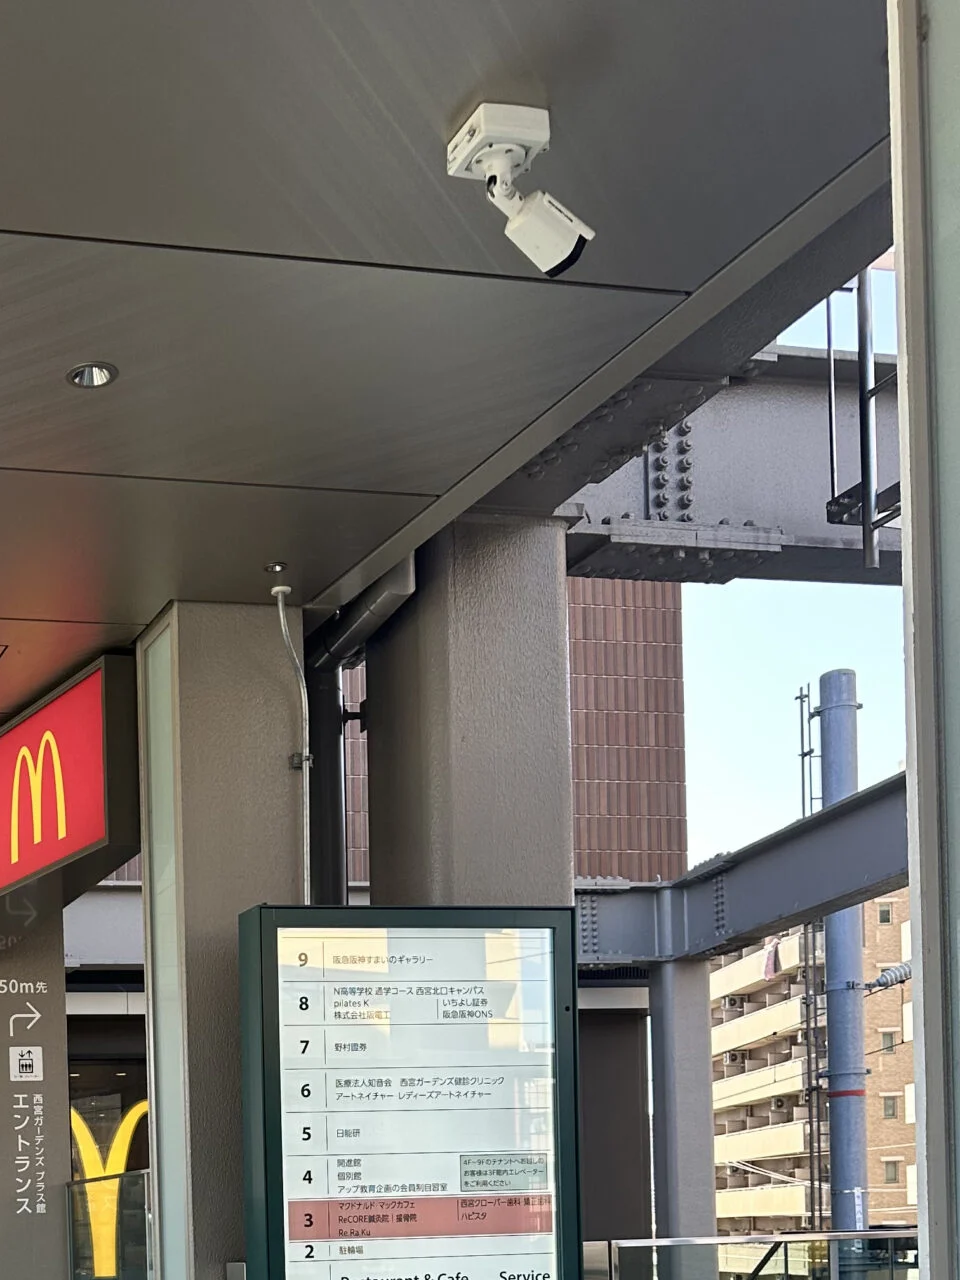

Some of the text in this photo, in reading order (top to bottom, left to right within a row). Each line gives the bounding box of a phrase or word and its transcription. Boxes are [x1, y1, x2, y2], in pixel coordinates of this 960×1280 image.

[297, 953, 309, 967] 9
[332, 955, 434, 965] 阪急阪神すまいのギャラリー
[333, 986, 485, 996] N高等学校 通学コース 西宮北口キャンパス
[299, 996, 310, 1011] 8
[333, 999, 370, 1008] pilates K
[442, 998, 489, 1007] いちよし証券
[300, 1040, 310, 1055] 7
[300, 1083, 311, 1098] 6
[335, 1090, 492, 1101] アートネイチャー レディーズアートネイチャー
[301, 1127, 312, 1141] 5
[336, 1128, 361, 1138] 日能研
[13, 1094, 32, 1214] エントランス
[33, 1093, 47, 1214] 西宮ガーデンズ プラス館
[302, 1170, 313, 1184] 4
[303, 1213, 314, 1228] 3
[461, 1211, 487, 1221] ハピスタ
[304, 1244, 315, 1259] 2
